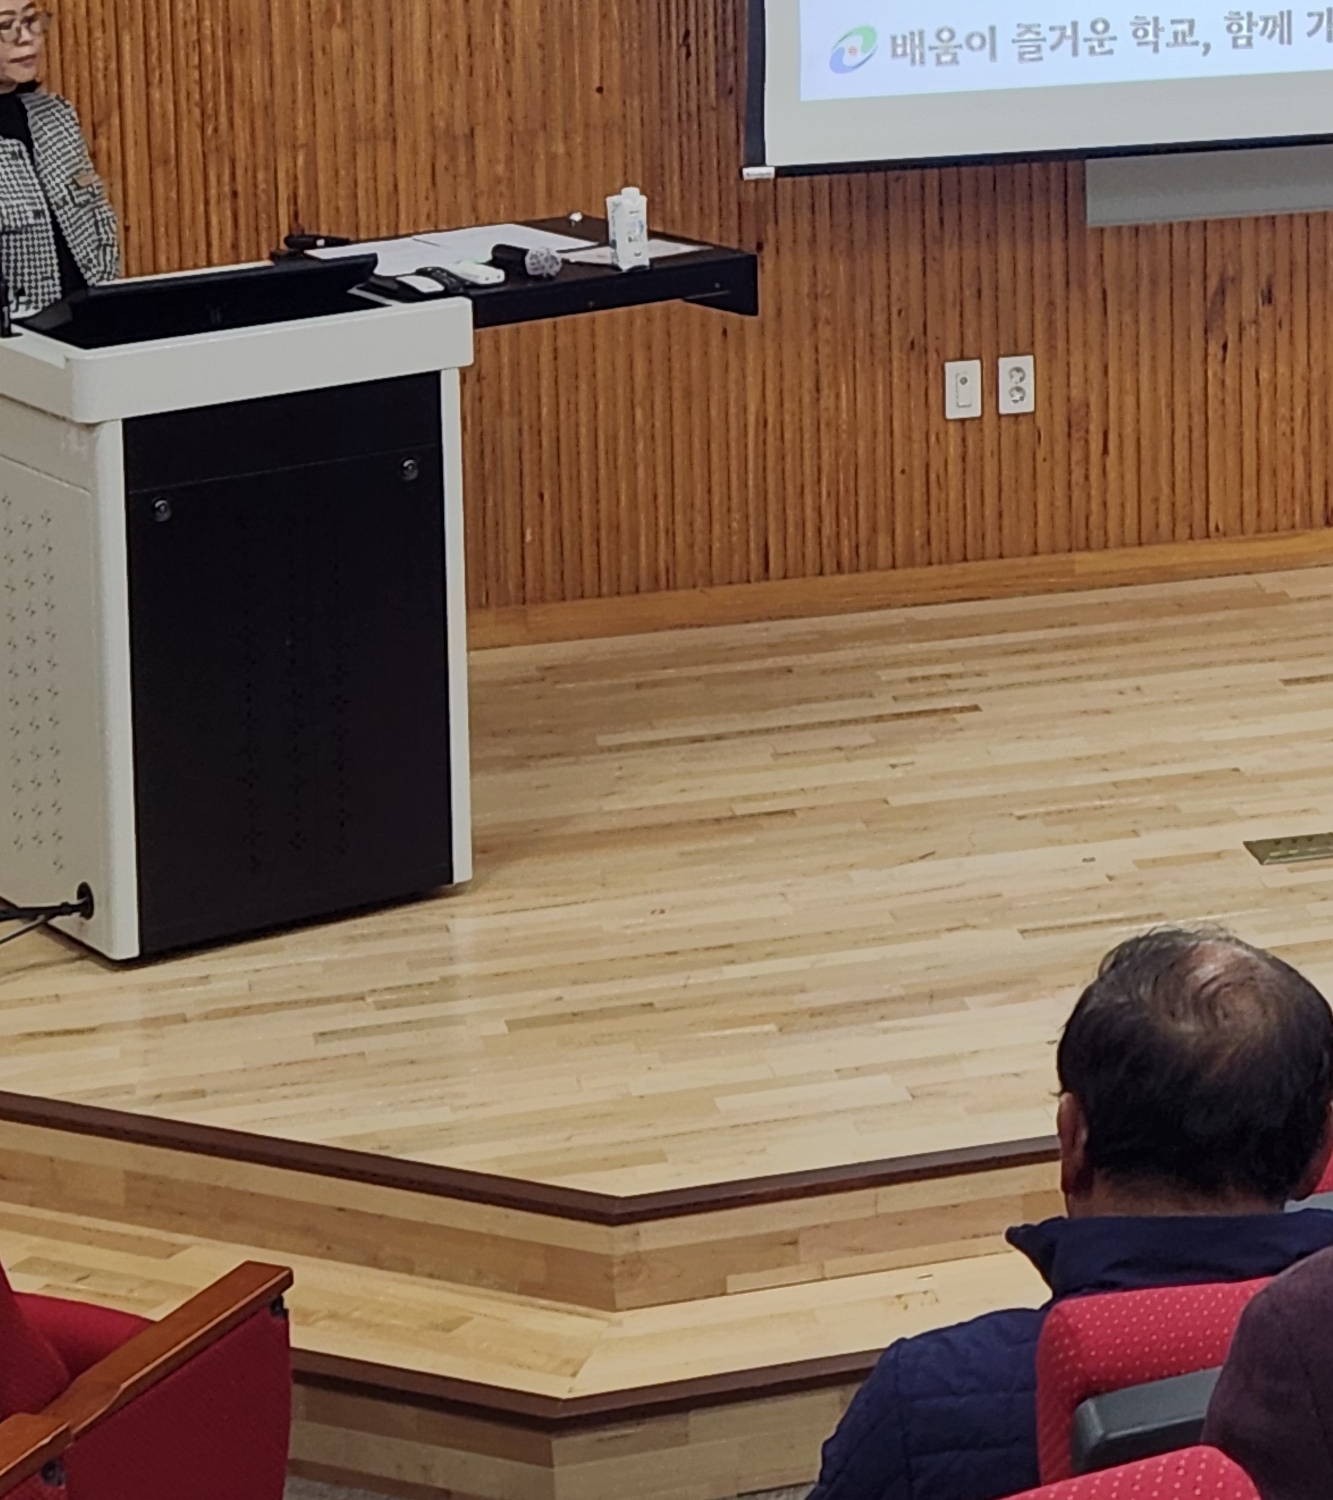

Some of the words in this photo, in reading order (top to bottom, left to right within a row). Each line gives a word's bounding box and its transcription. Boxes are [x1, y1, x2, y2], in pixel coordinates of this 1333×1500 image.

[889, 24, 998, 67] 배움이
[1011, 16, 1118, 64] 즐거운
[1129, 15, 1212, 57] 학교,
[1224, 9, 1293, 50] 함께
